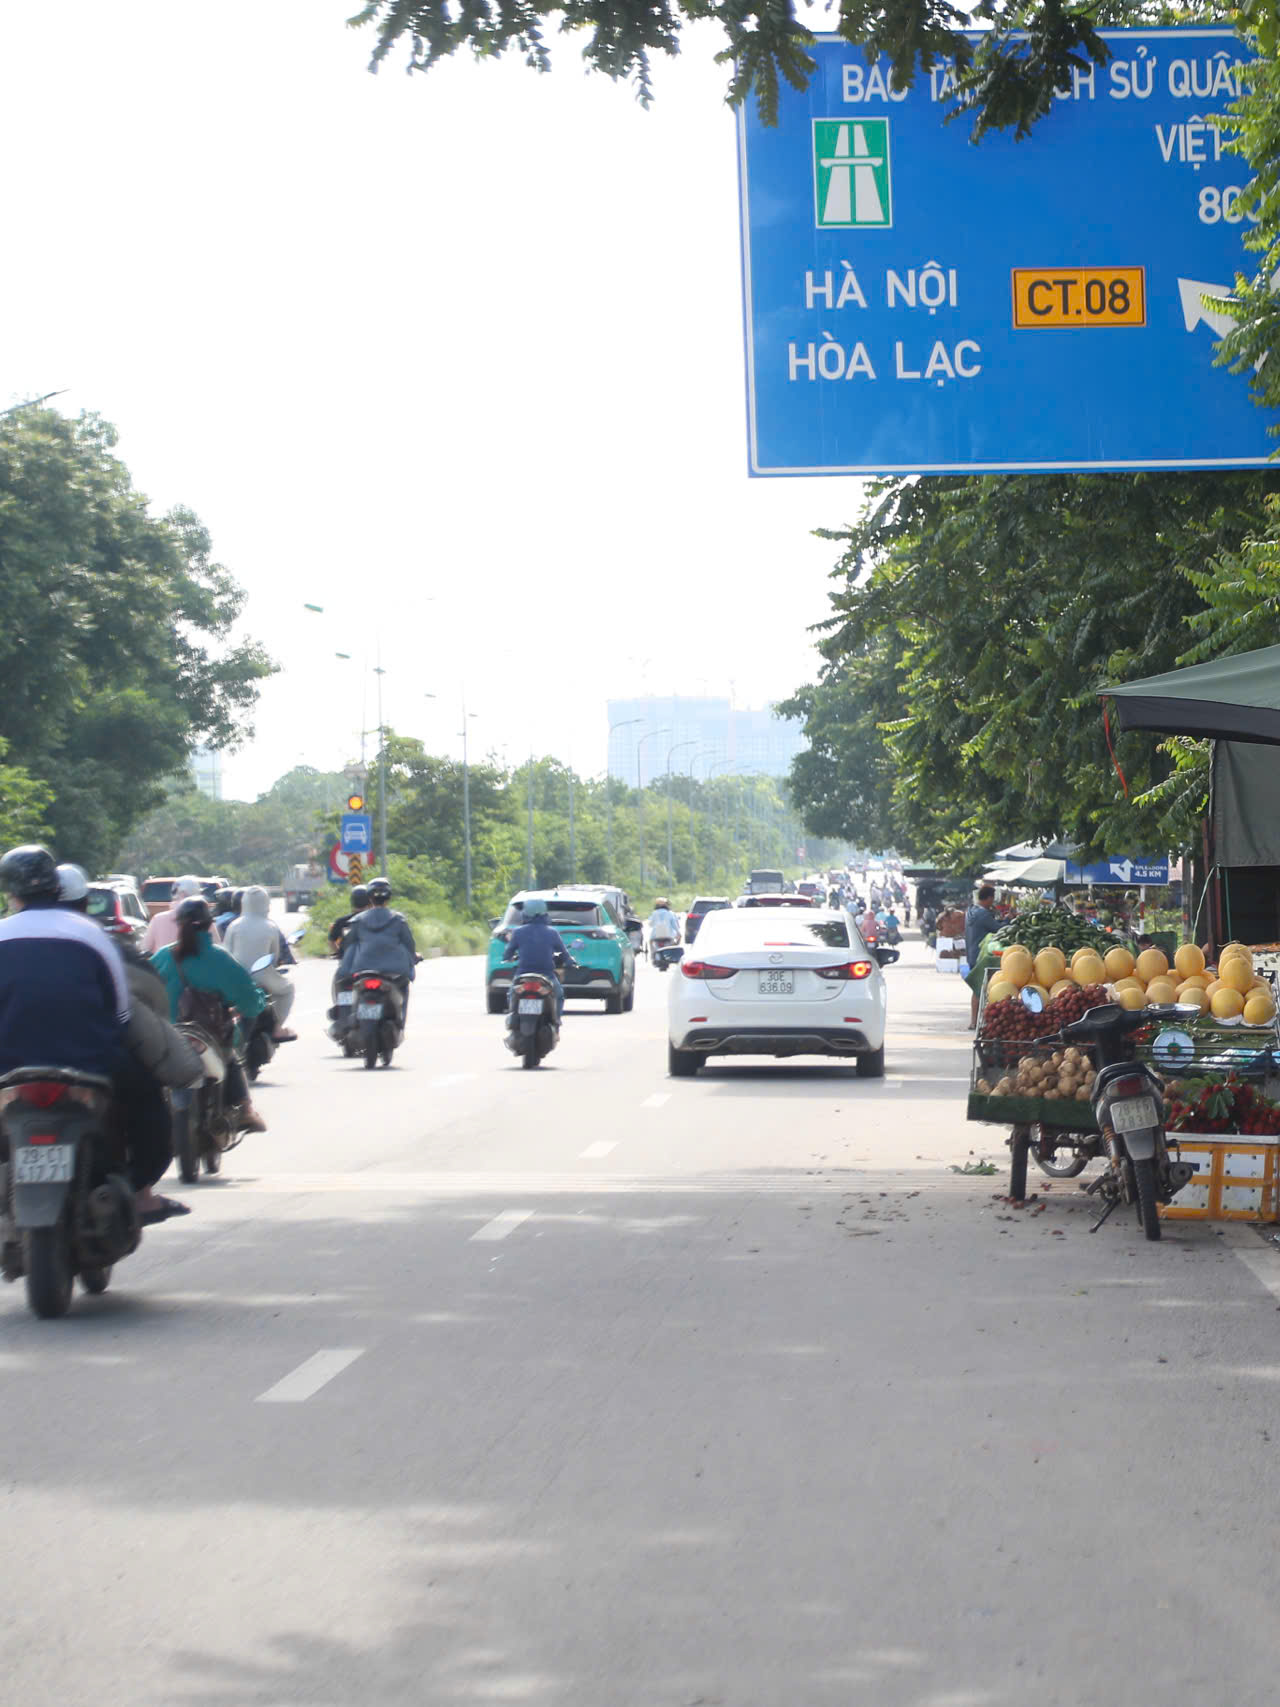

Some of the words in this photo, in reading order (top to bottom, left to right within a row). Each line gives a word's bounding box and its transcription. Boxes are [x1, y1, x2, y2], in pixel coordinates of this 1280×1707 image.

[1109, 45, 1157, 99] SỬ
[805, 260, 868, 309] HÀ
[886, 260, 957, 315] NỘI
[1028, 279, 1131, 316] CT.08
[788, 331, 877, 381] HÒA
[895, 340, 982, 387] LẠC
[767, 970, 785, 982] 30E
